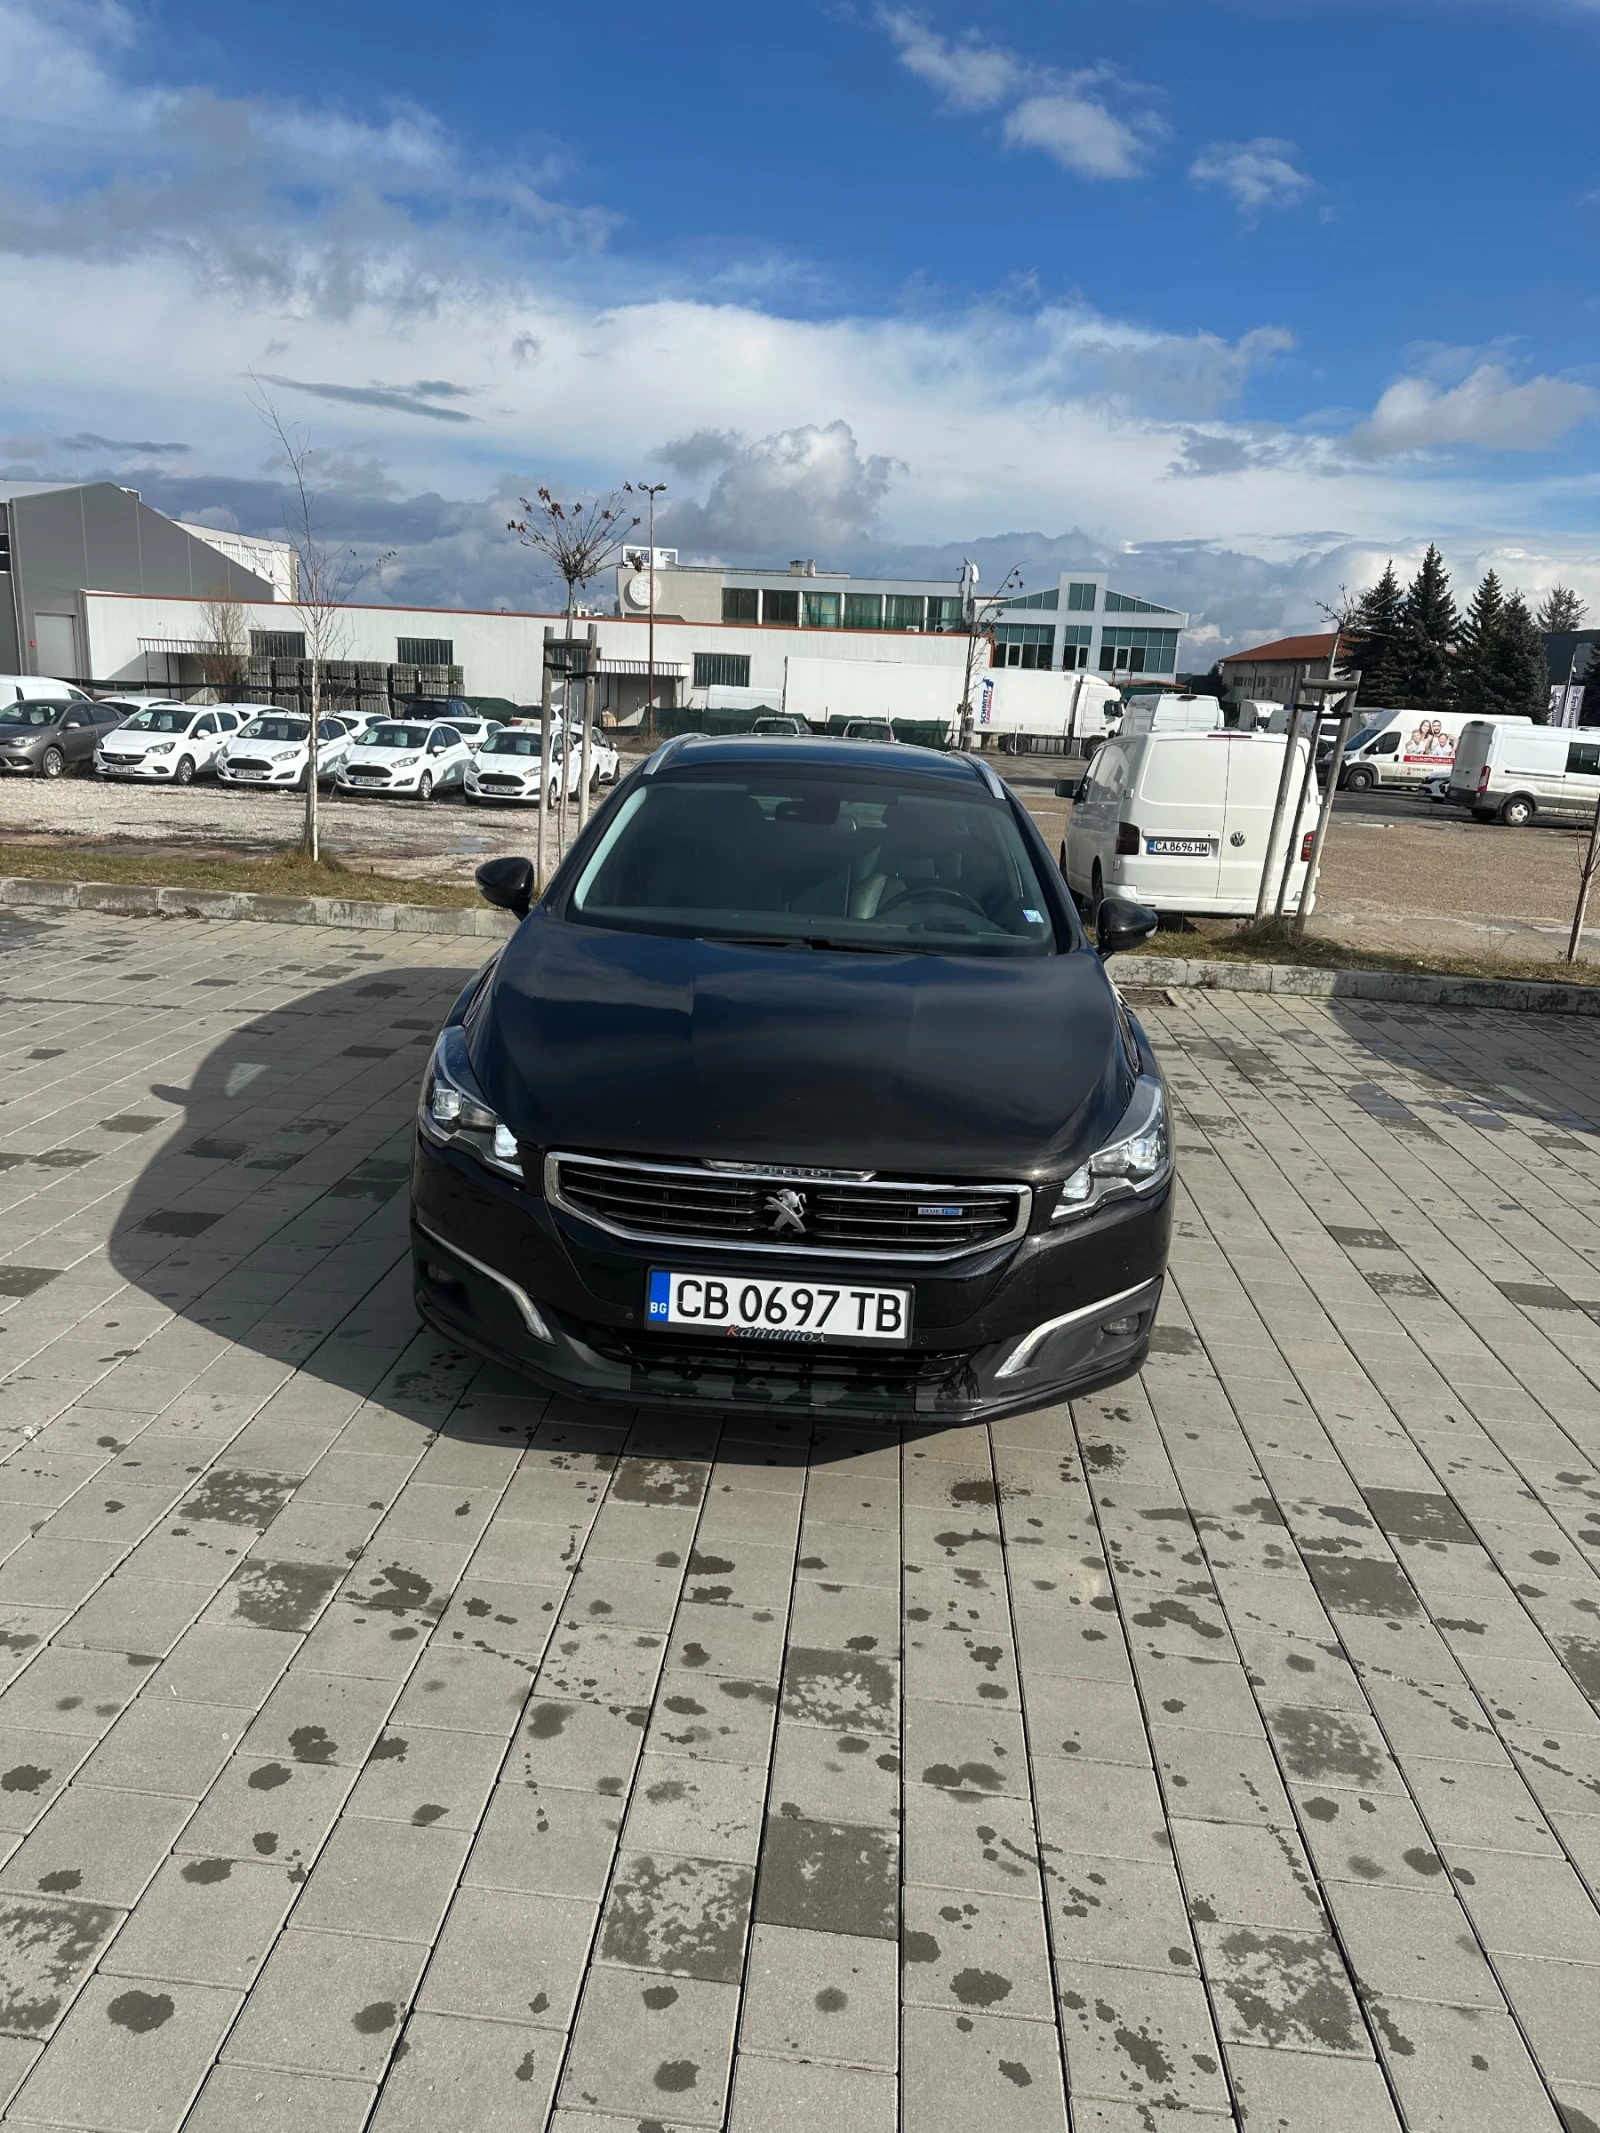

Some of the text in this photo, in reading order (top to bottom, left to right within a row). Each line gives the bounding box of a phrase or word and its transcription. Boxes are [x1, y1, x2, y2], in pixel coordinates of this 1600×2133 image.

[980, 689, 989, 724] SCHMITZ
[1155, 841, 1168, 851] CA
[1169, 841, 1193, 852] 8696
[650, 1301, 668, 1315] BG
[676, 1279, 902, 1333] CB 0697 TB
[726, 1324, 827, 1343] Капитол
